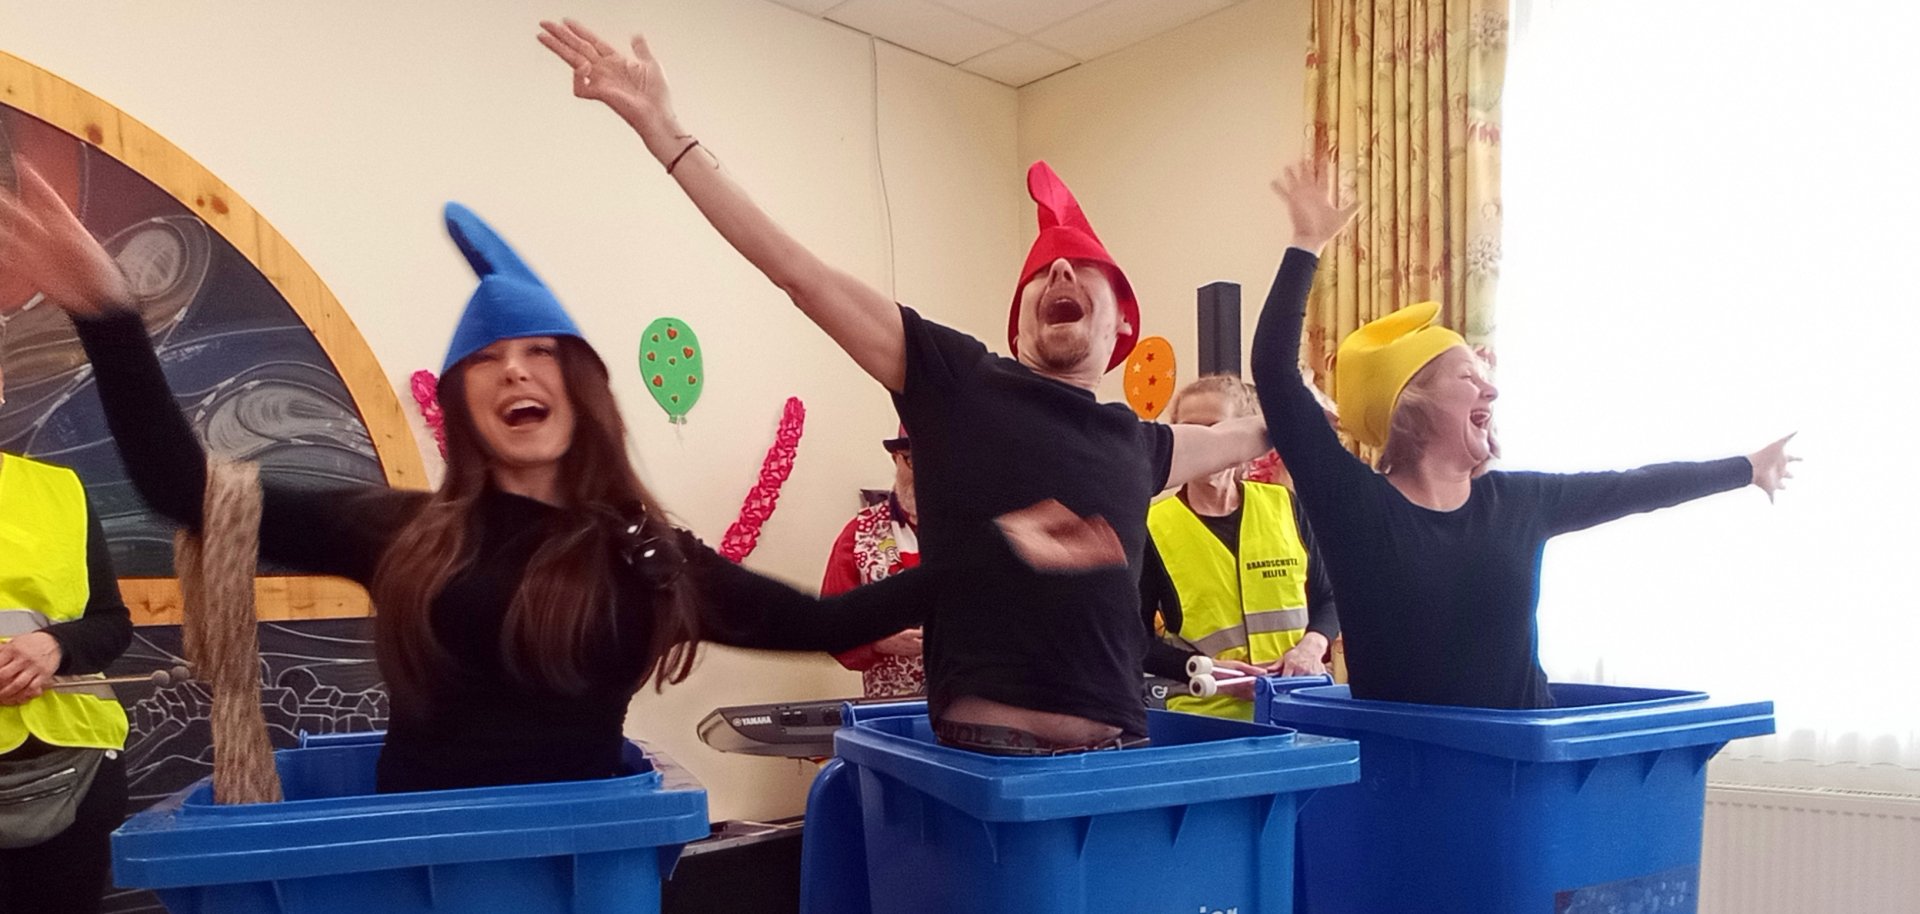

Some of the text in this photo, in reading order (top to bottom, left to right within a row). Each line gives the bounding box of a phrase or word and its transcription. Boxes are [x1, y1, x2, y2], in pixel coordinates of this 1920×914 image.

[1246, 558, 1298, 570] BRANDSCHUTZ
[1262, 569, 1287, 578] HELFER
[741, 715, 772, 726] YAMAHA
